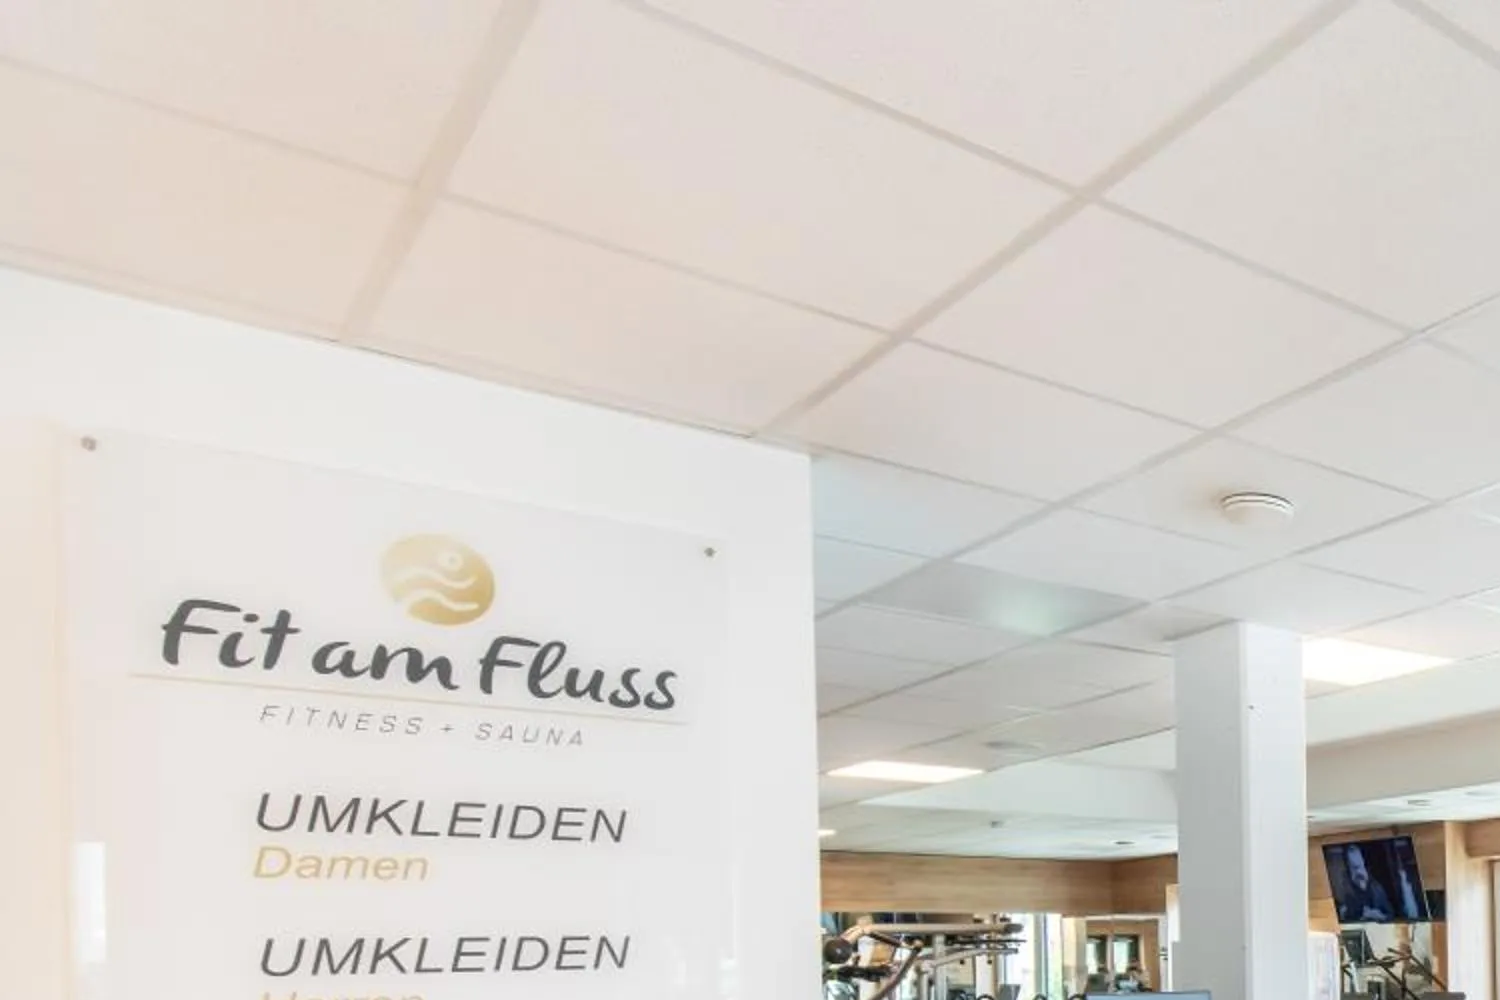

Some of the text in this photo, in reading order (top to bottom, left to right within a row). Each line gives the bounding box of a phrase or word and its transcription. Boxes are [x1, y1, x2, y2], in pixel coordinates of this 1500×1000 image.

[161, 598, 678, 711] Fit am Fluss
[258, 704, 424, 736] FITNESS
[474, 721, 584, 748] SAUNA
[255, 792, 628, 844] UMKLEIDEN
[252, 845, 429, 883] Damen
[259, 935, 631, 978] UMKLEIDEN
